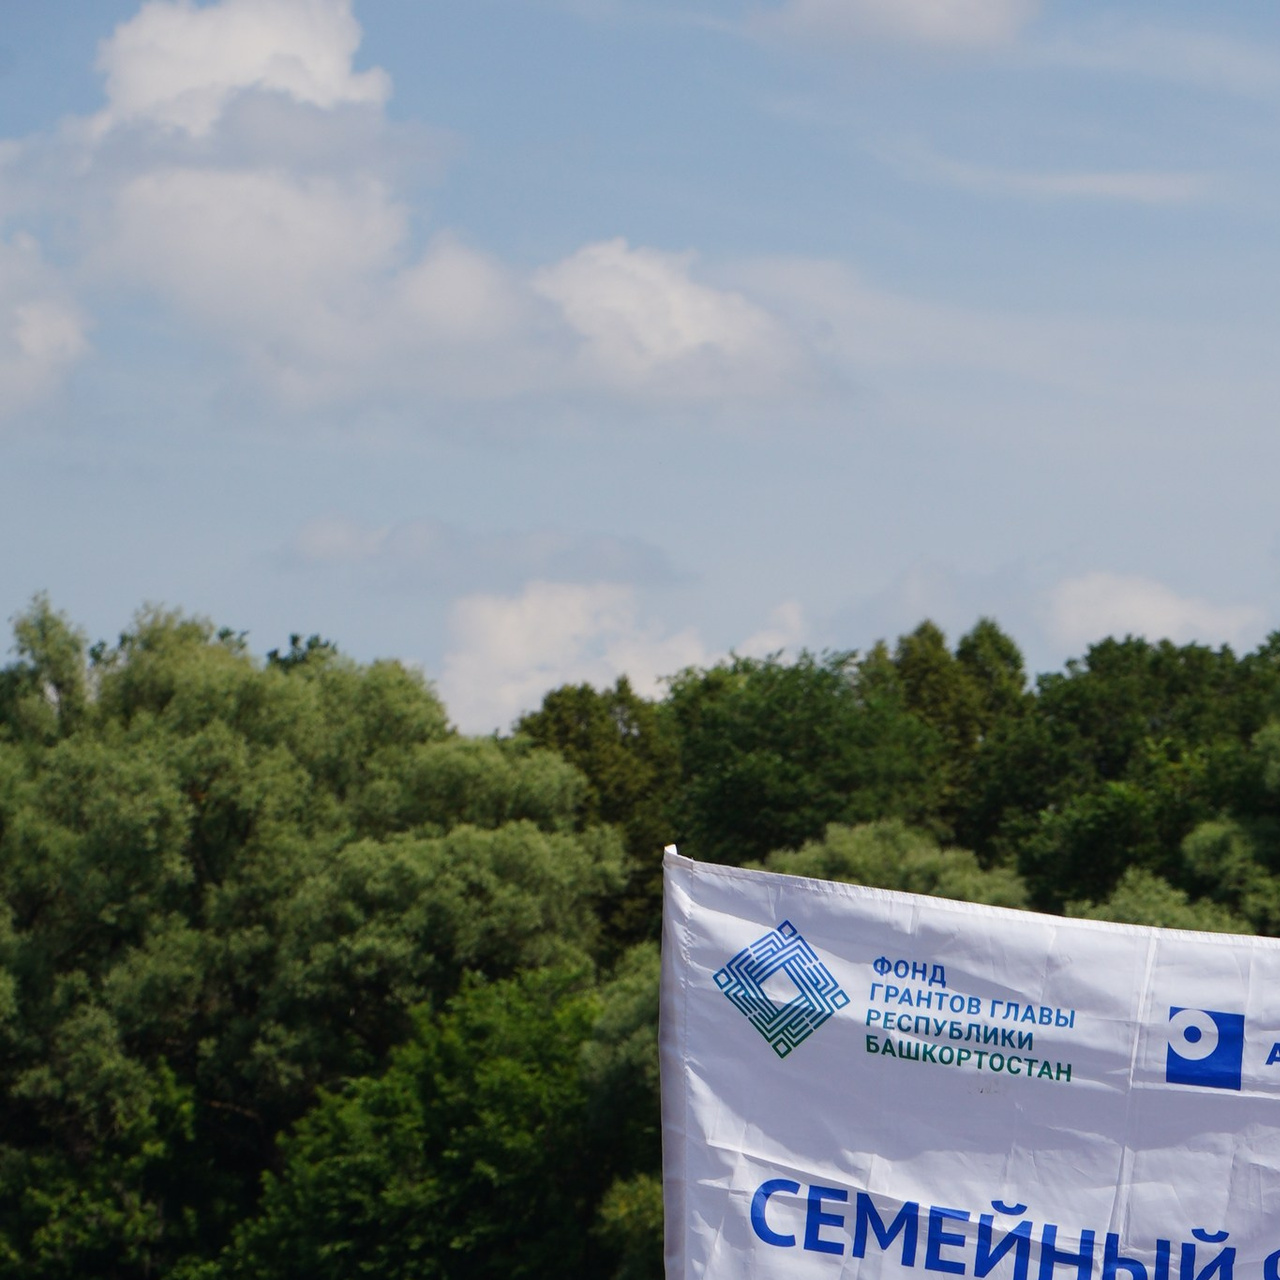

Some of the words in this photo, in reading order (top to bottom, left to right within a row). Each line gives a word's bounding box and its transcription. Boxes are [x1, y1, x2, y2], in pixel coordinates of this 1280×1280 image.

[873, 956, 946, 988] ФОНД
[869, 982, 981, 1015] ГРАНТОВ
[990, 1000, 1075, 1028] ГЛАВЫ
[865, 1008, 1033, 1051] РЕСПУБЛИКИ
[865, 1034, 1072, 1082] БАШКОРТОСТАН
